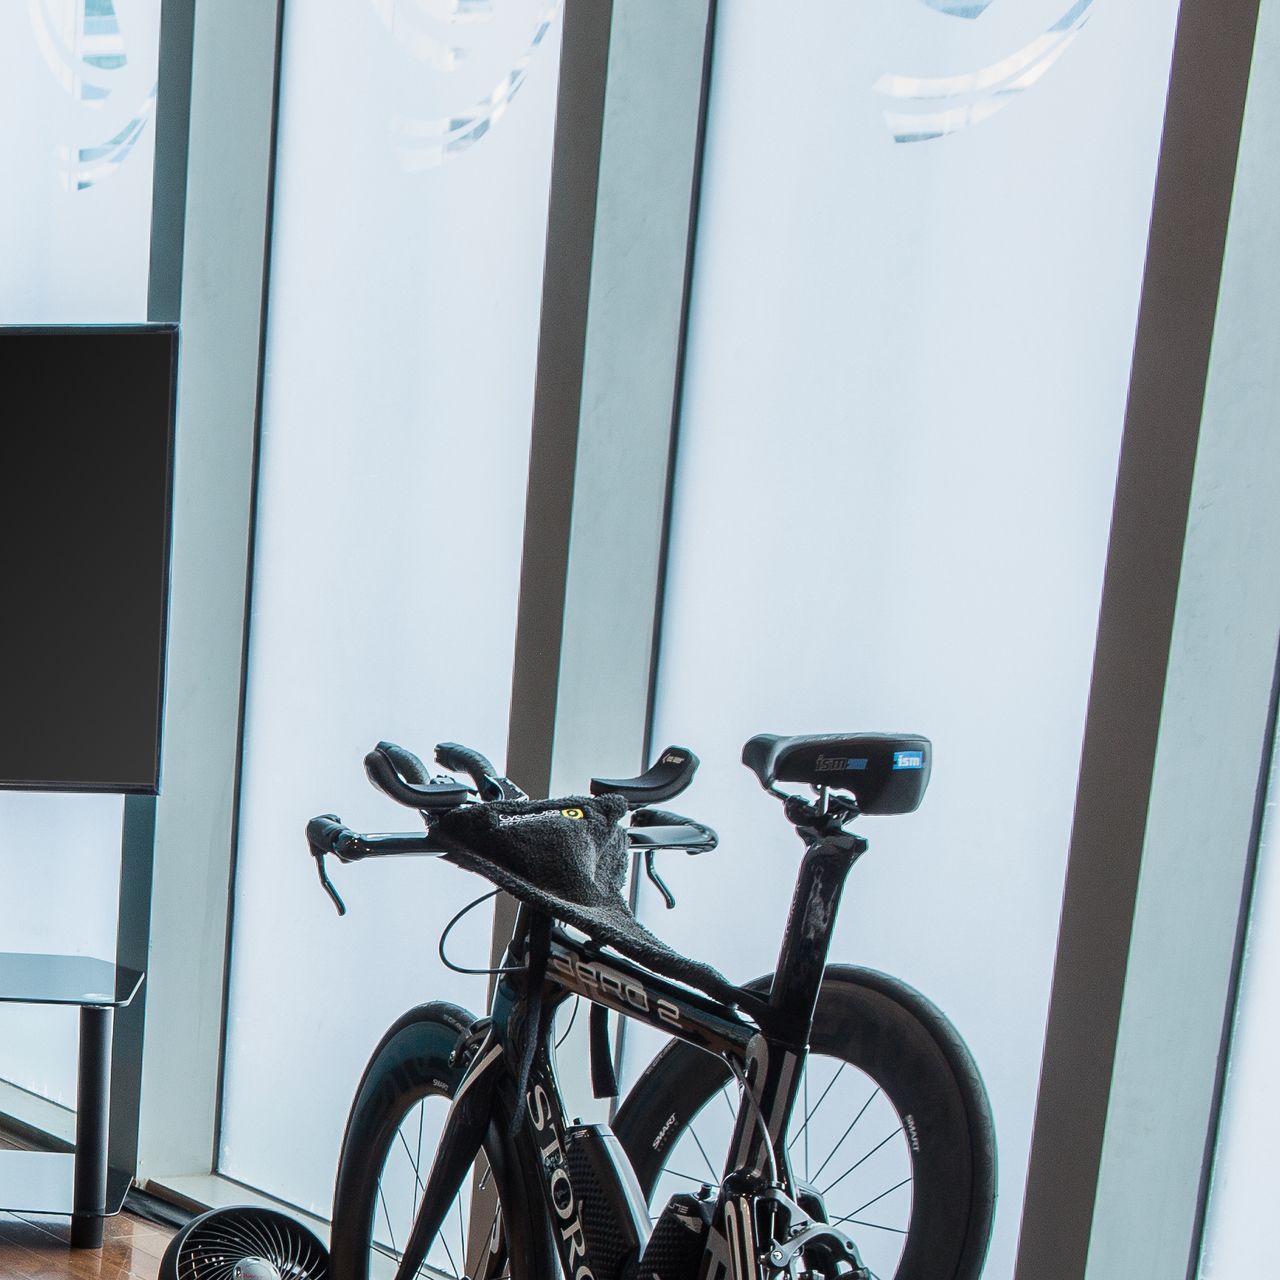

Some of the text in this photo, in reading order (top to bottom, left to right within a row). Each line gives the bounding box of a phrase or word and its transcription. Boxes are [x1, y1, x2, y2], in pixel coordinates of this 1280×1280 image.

[897, 754, 921, 767] ism
[651, 1111, 677, 1151] SMART
[904, 1113, 921, 1154] SMART
